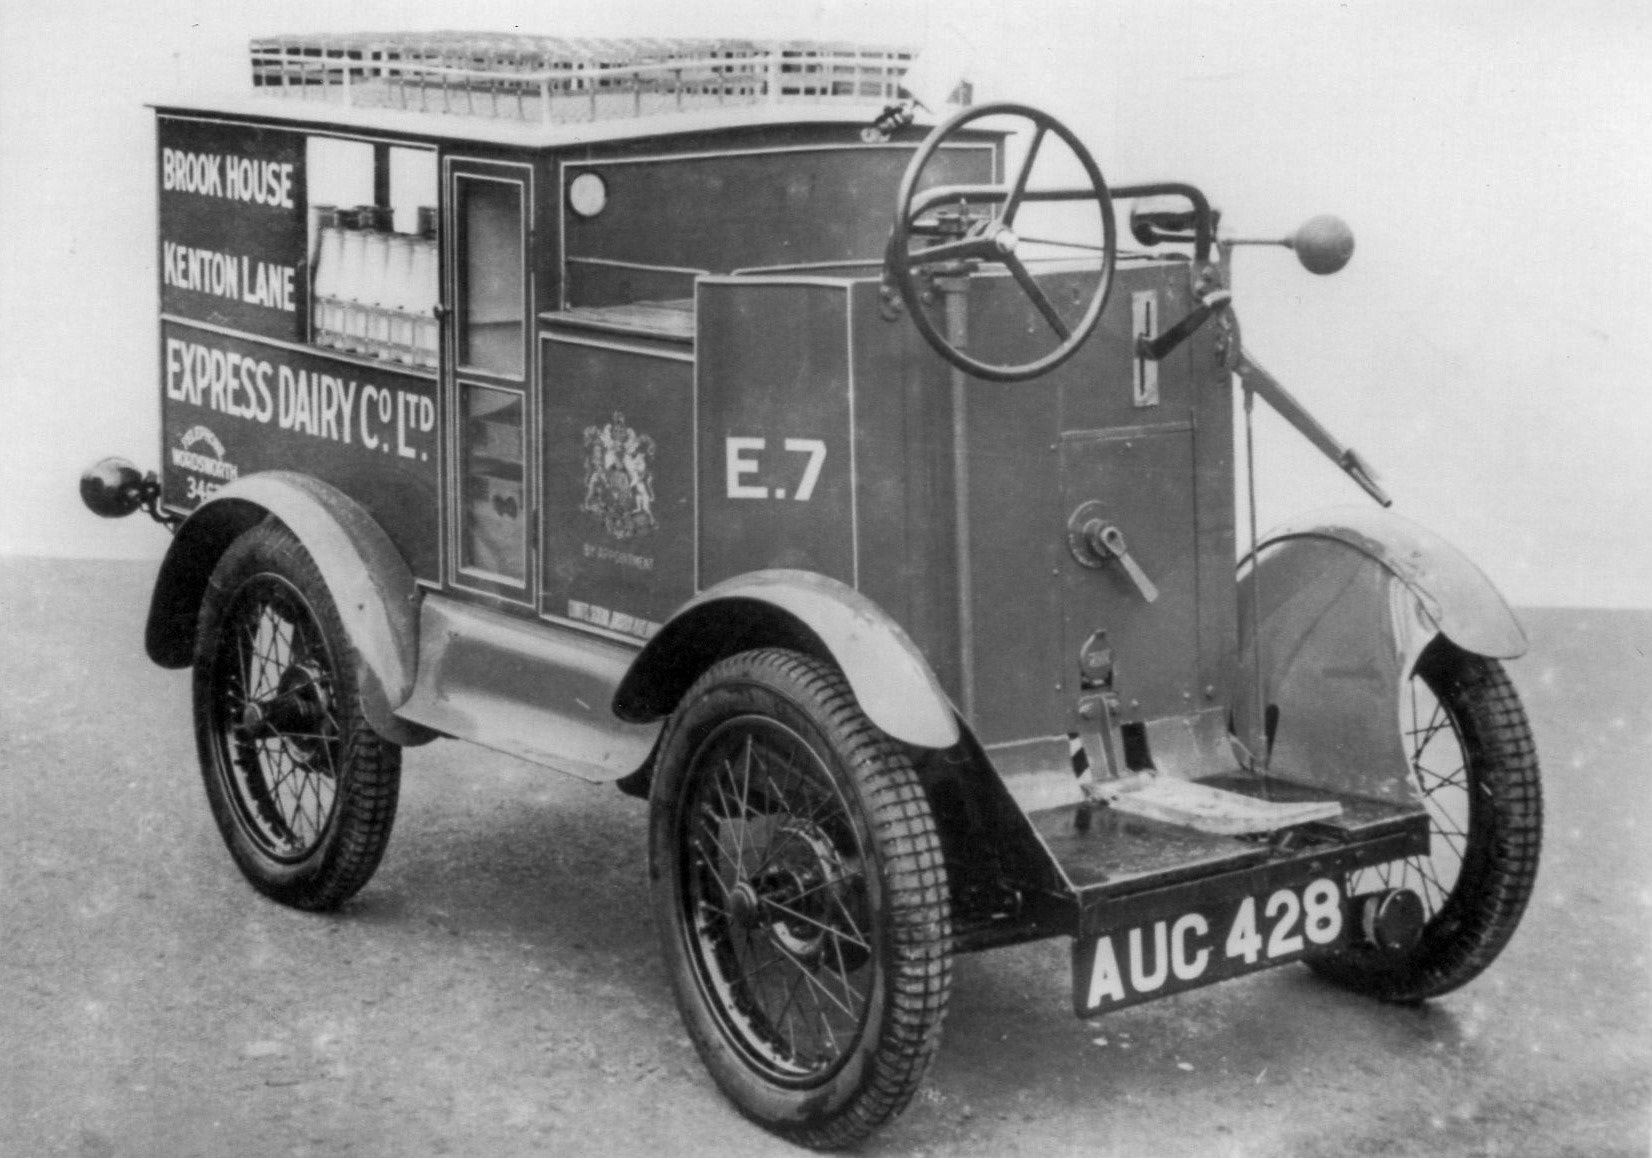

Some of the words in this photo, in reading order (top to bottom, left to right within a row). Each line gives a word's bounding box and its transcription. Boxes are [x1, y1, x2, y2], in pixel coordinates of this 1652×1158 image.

[163, 147, 223, 198] BROOK
[226, 155, 294, 209] HOUSE
[164, 240, 239, 300] KENTON
[243, 255, 296, 312] LANE
[167, 337, 274, 424] EXPRESS
[278, 364, 357, 444] DAIRY
[726, 436, 827, 501] E.7
[1086, 913, 1210, 1010] AUC
[1225, 878, 1343, 965] 428
